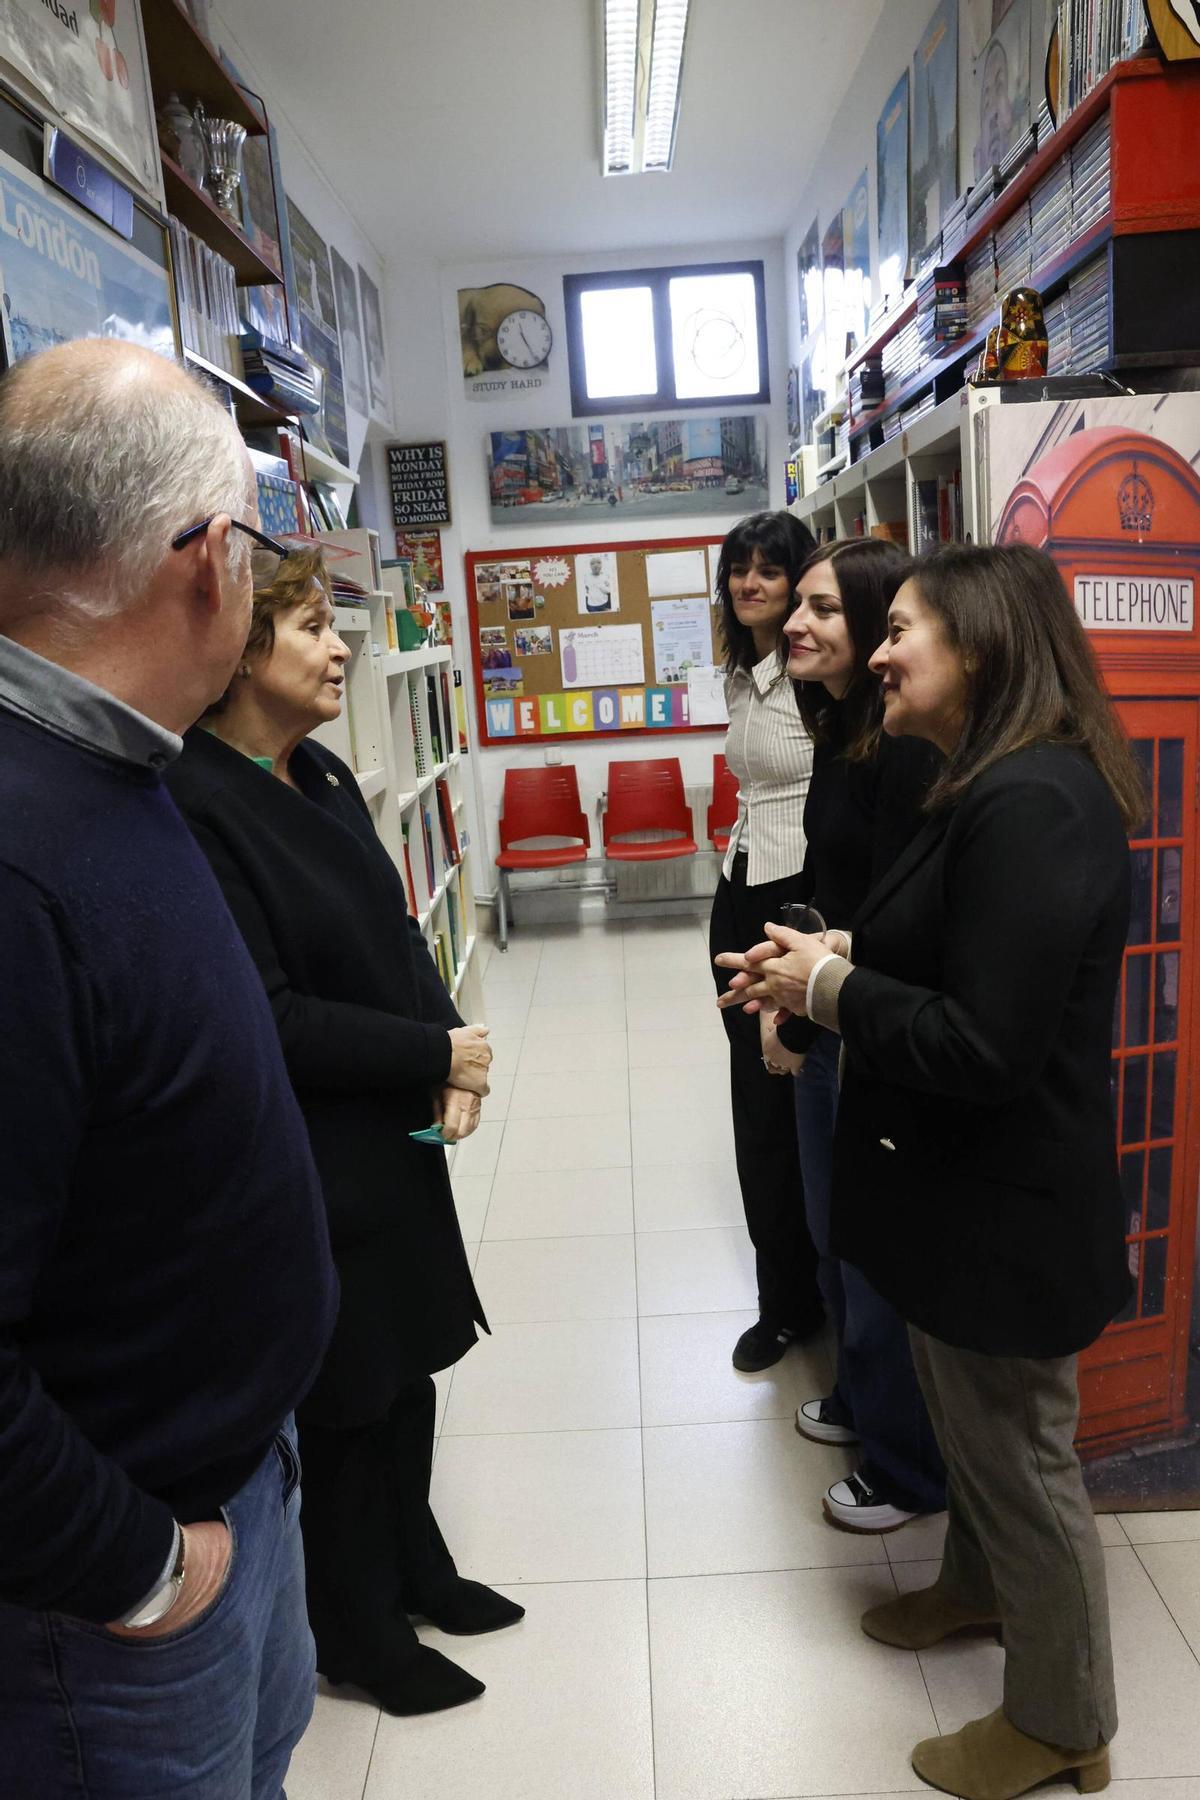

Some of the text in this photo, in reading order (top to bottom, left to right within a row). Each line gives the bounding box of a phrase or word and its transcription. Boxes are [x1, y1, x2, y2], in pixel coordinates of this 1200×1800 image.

[0, 178, 102, 290] London
[472, 379, 542, 392] STUDY HARD
[390, 446, 443, 461] WHY IS
[391, 461, 443, 473] MONDAY
[421, 471, 445, 479] FROM
[392, 480, 445, 490] FRIDAY AND
[393, 489, 445, 502] FRIDAY
[394, 501, 447, 514] SO NEAR
[409, 513, 448, 523] MONDAY
[1078, 581, 1189, 624] TELEPHONE
